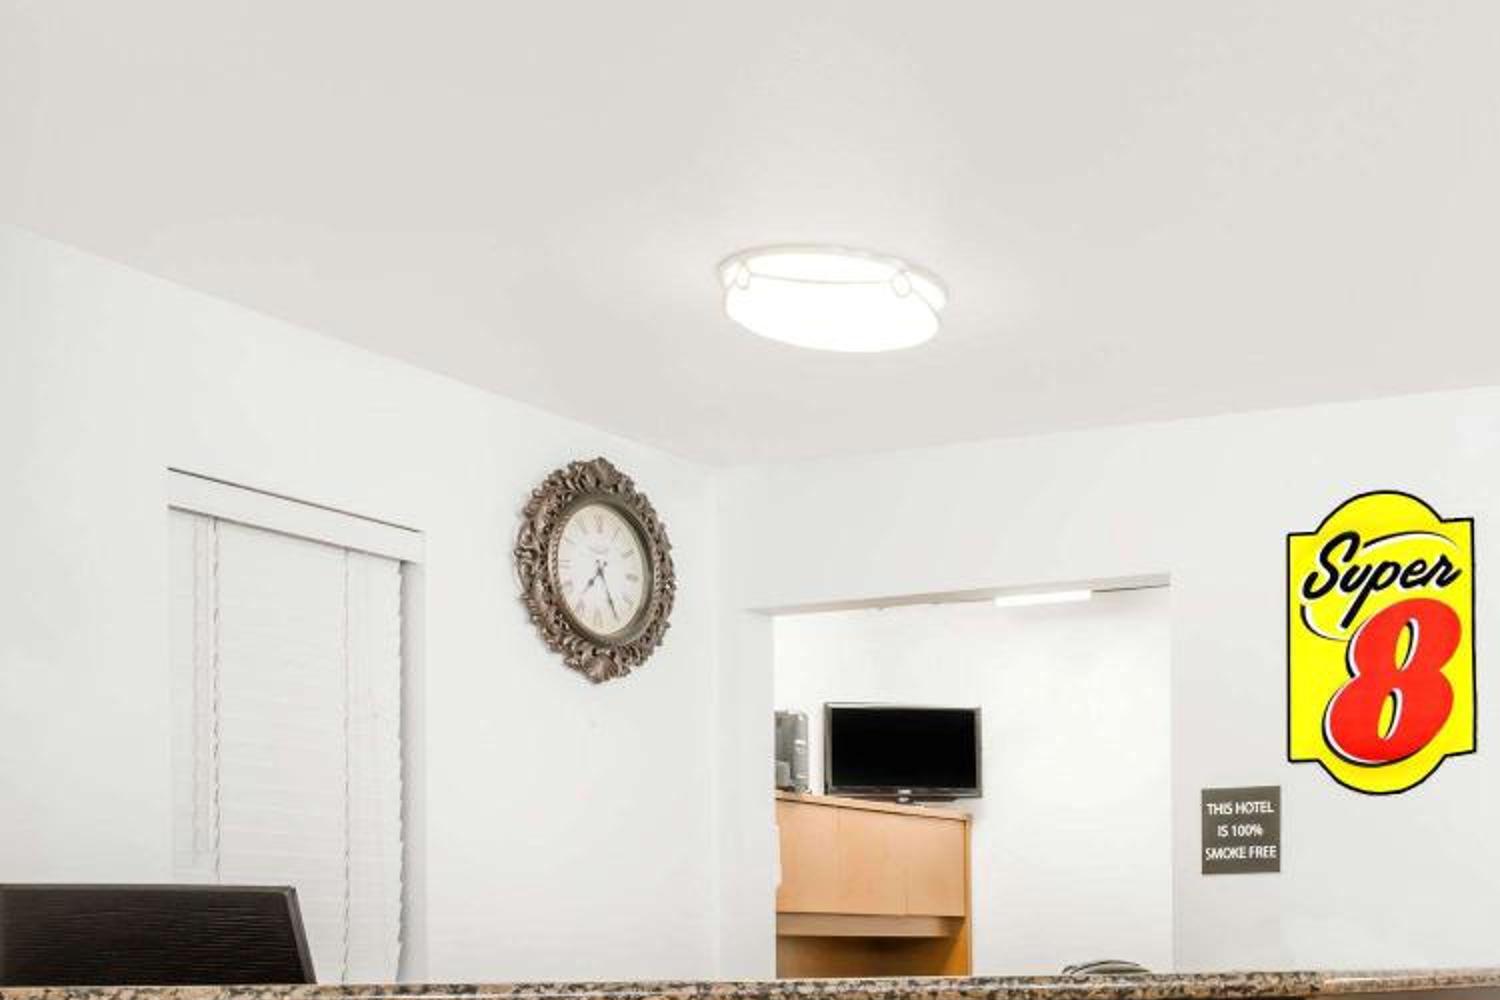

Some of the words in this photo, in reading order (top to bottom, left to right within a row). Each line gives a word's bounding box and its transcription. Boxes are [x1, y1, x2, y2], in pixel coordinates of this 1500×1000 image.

[1302, 531, 1463, 630] Super
[1321, 597, 1463, 768] 8
[1206, 802, 1233, 815] THIS
[1235, 800, 1274, 815] HOTEL
[1217, 824, 1229, 837] IS
[1231, 823, 1264, 837] 100%
[1205, 846, 1247, 860] SMOKE
[1249, 845, 1277, 859] FREE
